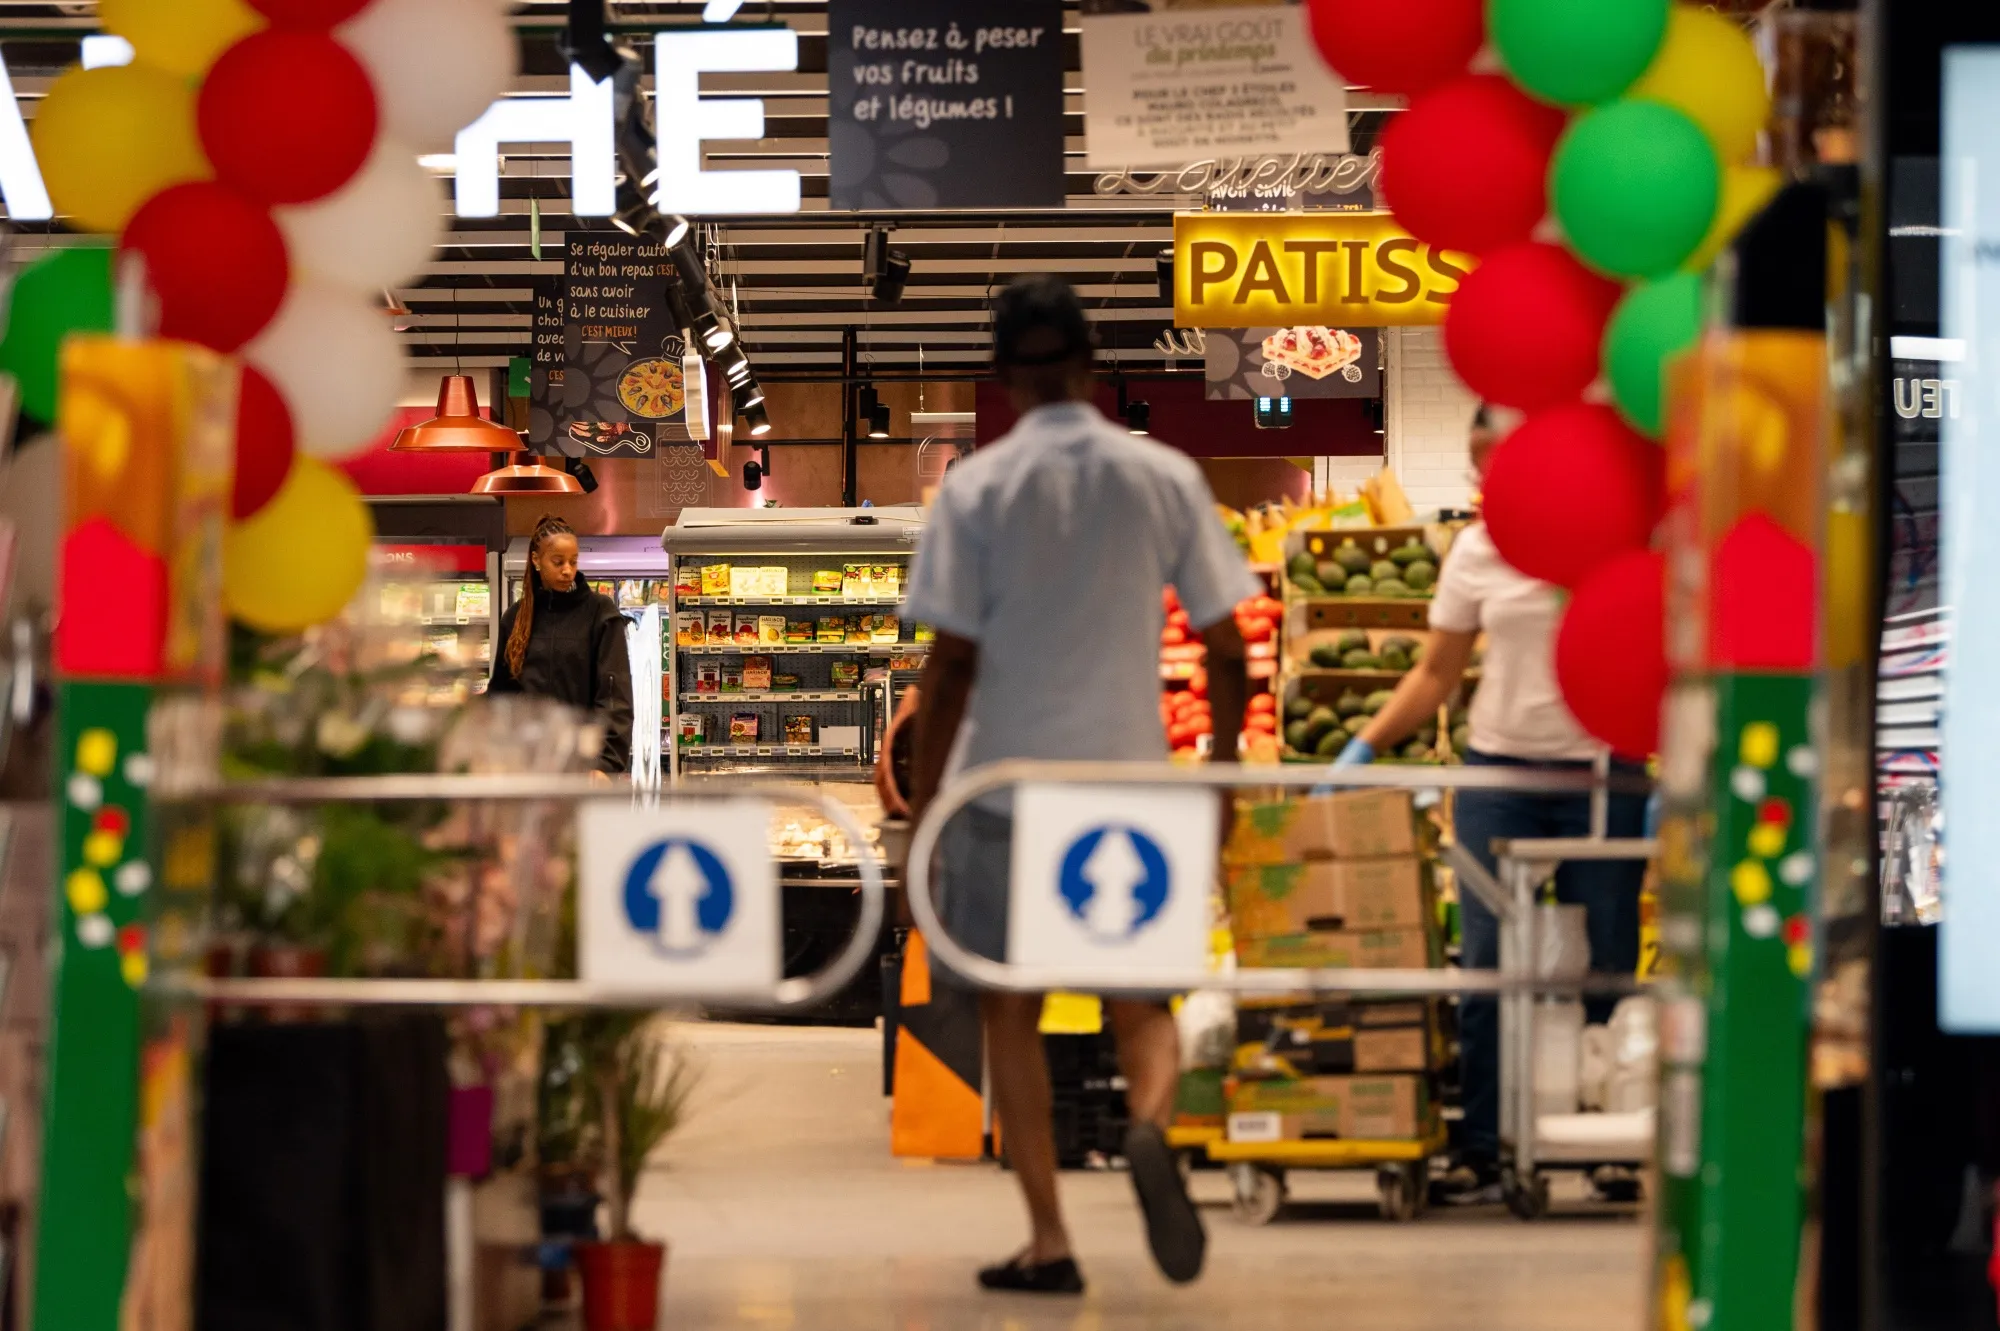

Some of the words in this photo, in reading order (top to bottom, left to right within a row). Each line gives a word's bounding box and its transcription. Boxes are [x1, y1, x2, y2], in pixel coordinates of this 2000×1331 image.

[853, 25, 938, 49] Pensez
[945, 22, 969, 50] à
[975, 27, 1044, 54] peser
[853, 64, 893, 84] vos
[901, 59, 979, 84] fruits
[853, 96, 881, 120] et
[890, 94, 998, 129] légumes
[1005, 95, 1014, 119] !
[570, 242, 584, 256] Se
[587, 241, 634, 261] régaler
[571, 261, 595, 277] d'un
[599, 262, 617, 277] bon
[621, 265, 654, 280] repas
[656, 264, 675, 276] C'EST
[1190, 238, 1473, 305] PATISS
[570, 286, 598, 298] sans
[602, 284, 634, 298] avoir
[538, 296, 552, 308] Un
[570, 303, 581, 318] à
[585, 304, 596, 318] le
[600, 304, 650, 318] cuisiner
[538, 313, 565, 326] choi
[582, 325, 603, 337] C'EST
[537, 334, 564, 345] avec
[537, 349, 551, 361] de
